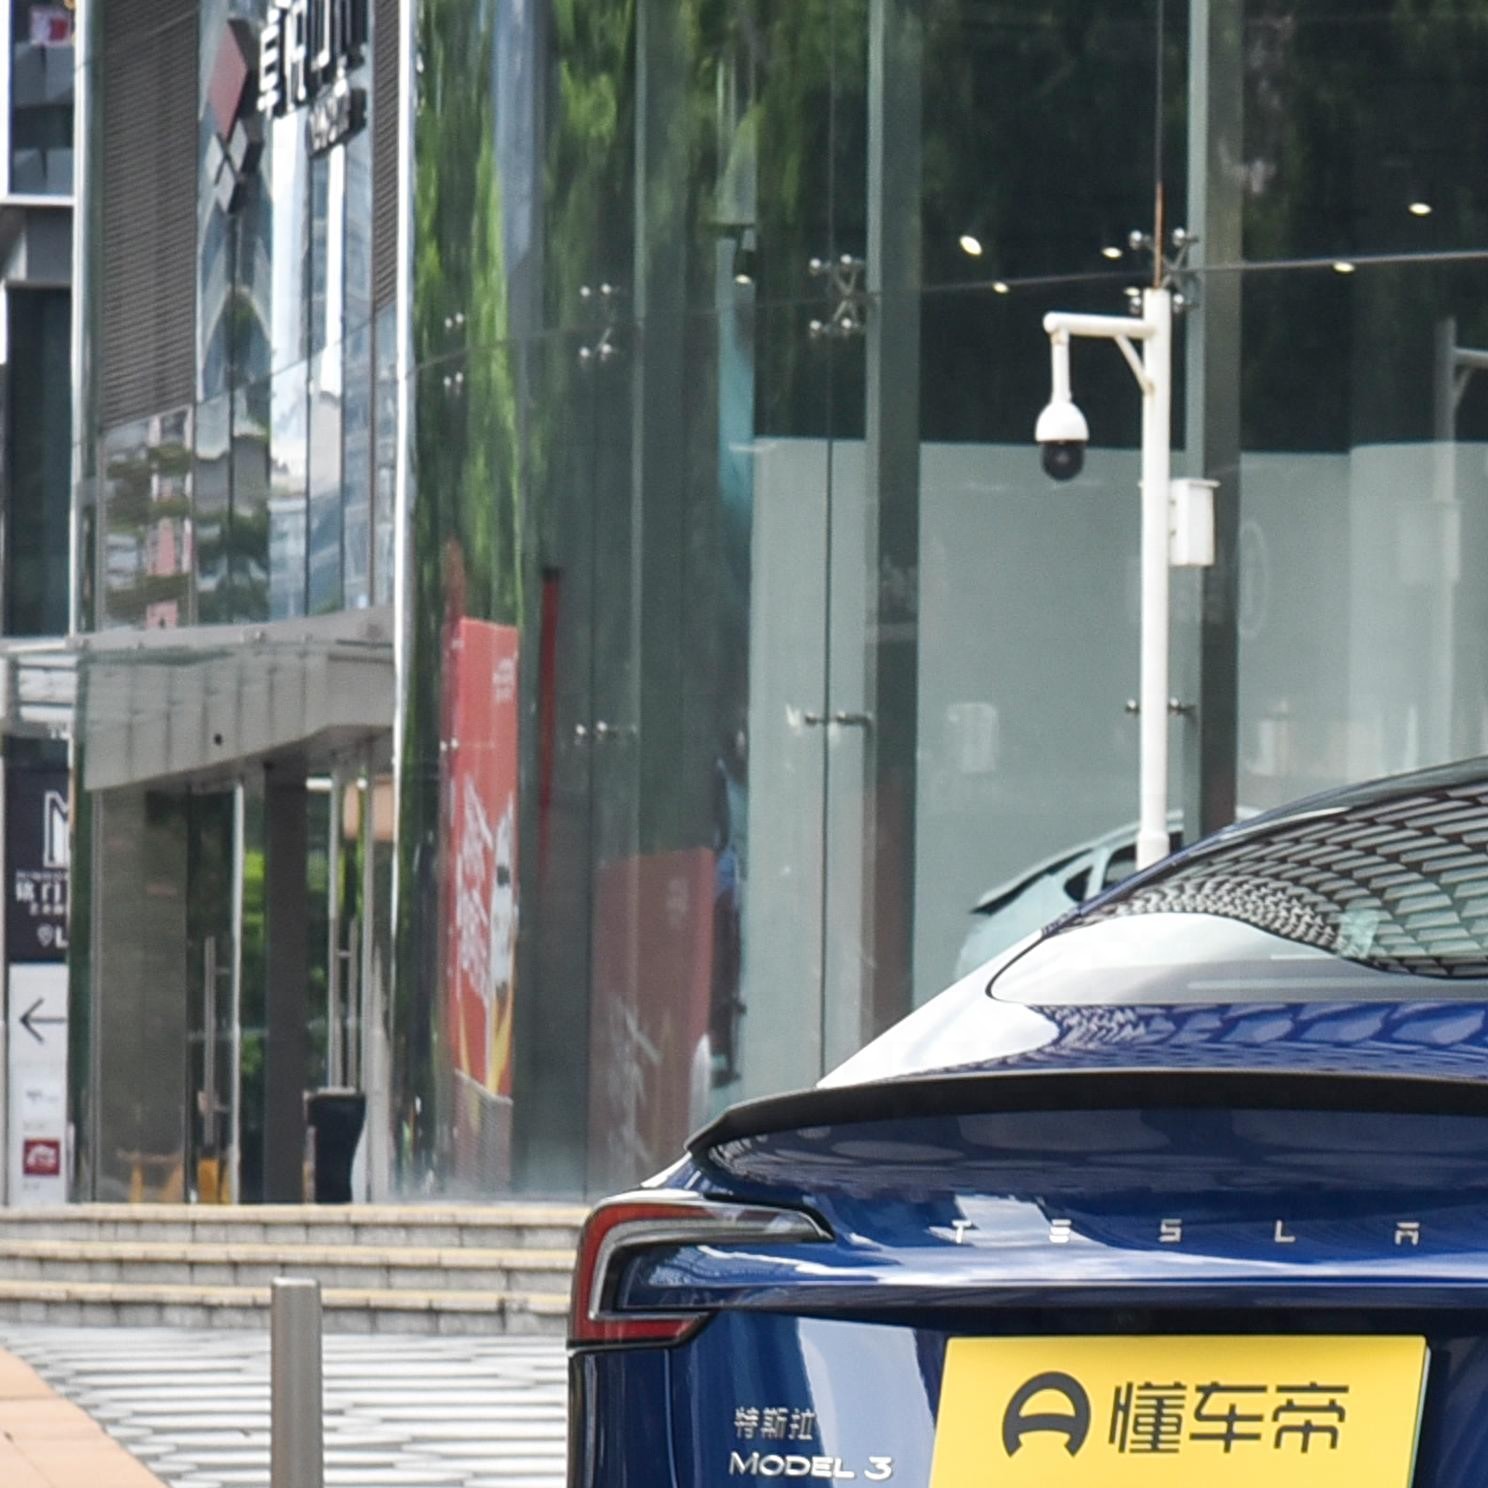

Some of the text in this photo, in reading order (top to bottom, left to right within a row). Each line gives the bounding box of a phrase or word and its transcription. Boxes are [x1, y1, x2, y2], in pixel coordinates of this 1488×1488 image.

[952, 1218, 1420, 1245] TESLA
[734, 1406, 816, 1440] 特斯拉
[1108, 1382, 1349, 1453] 懂车帝
[729, 1452, 892, 1480] MODEL 3
